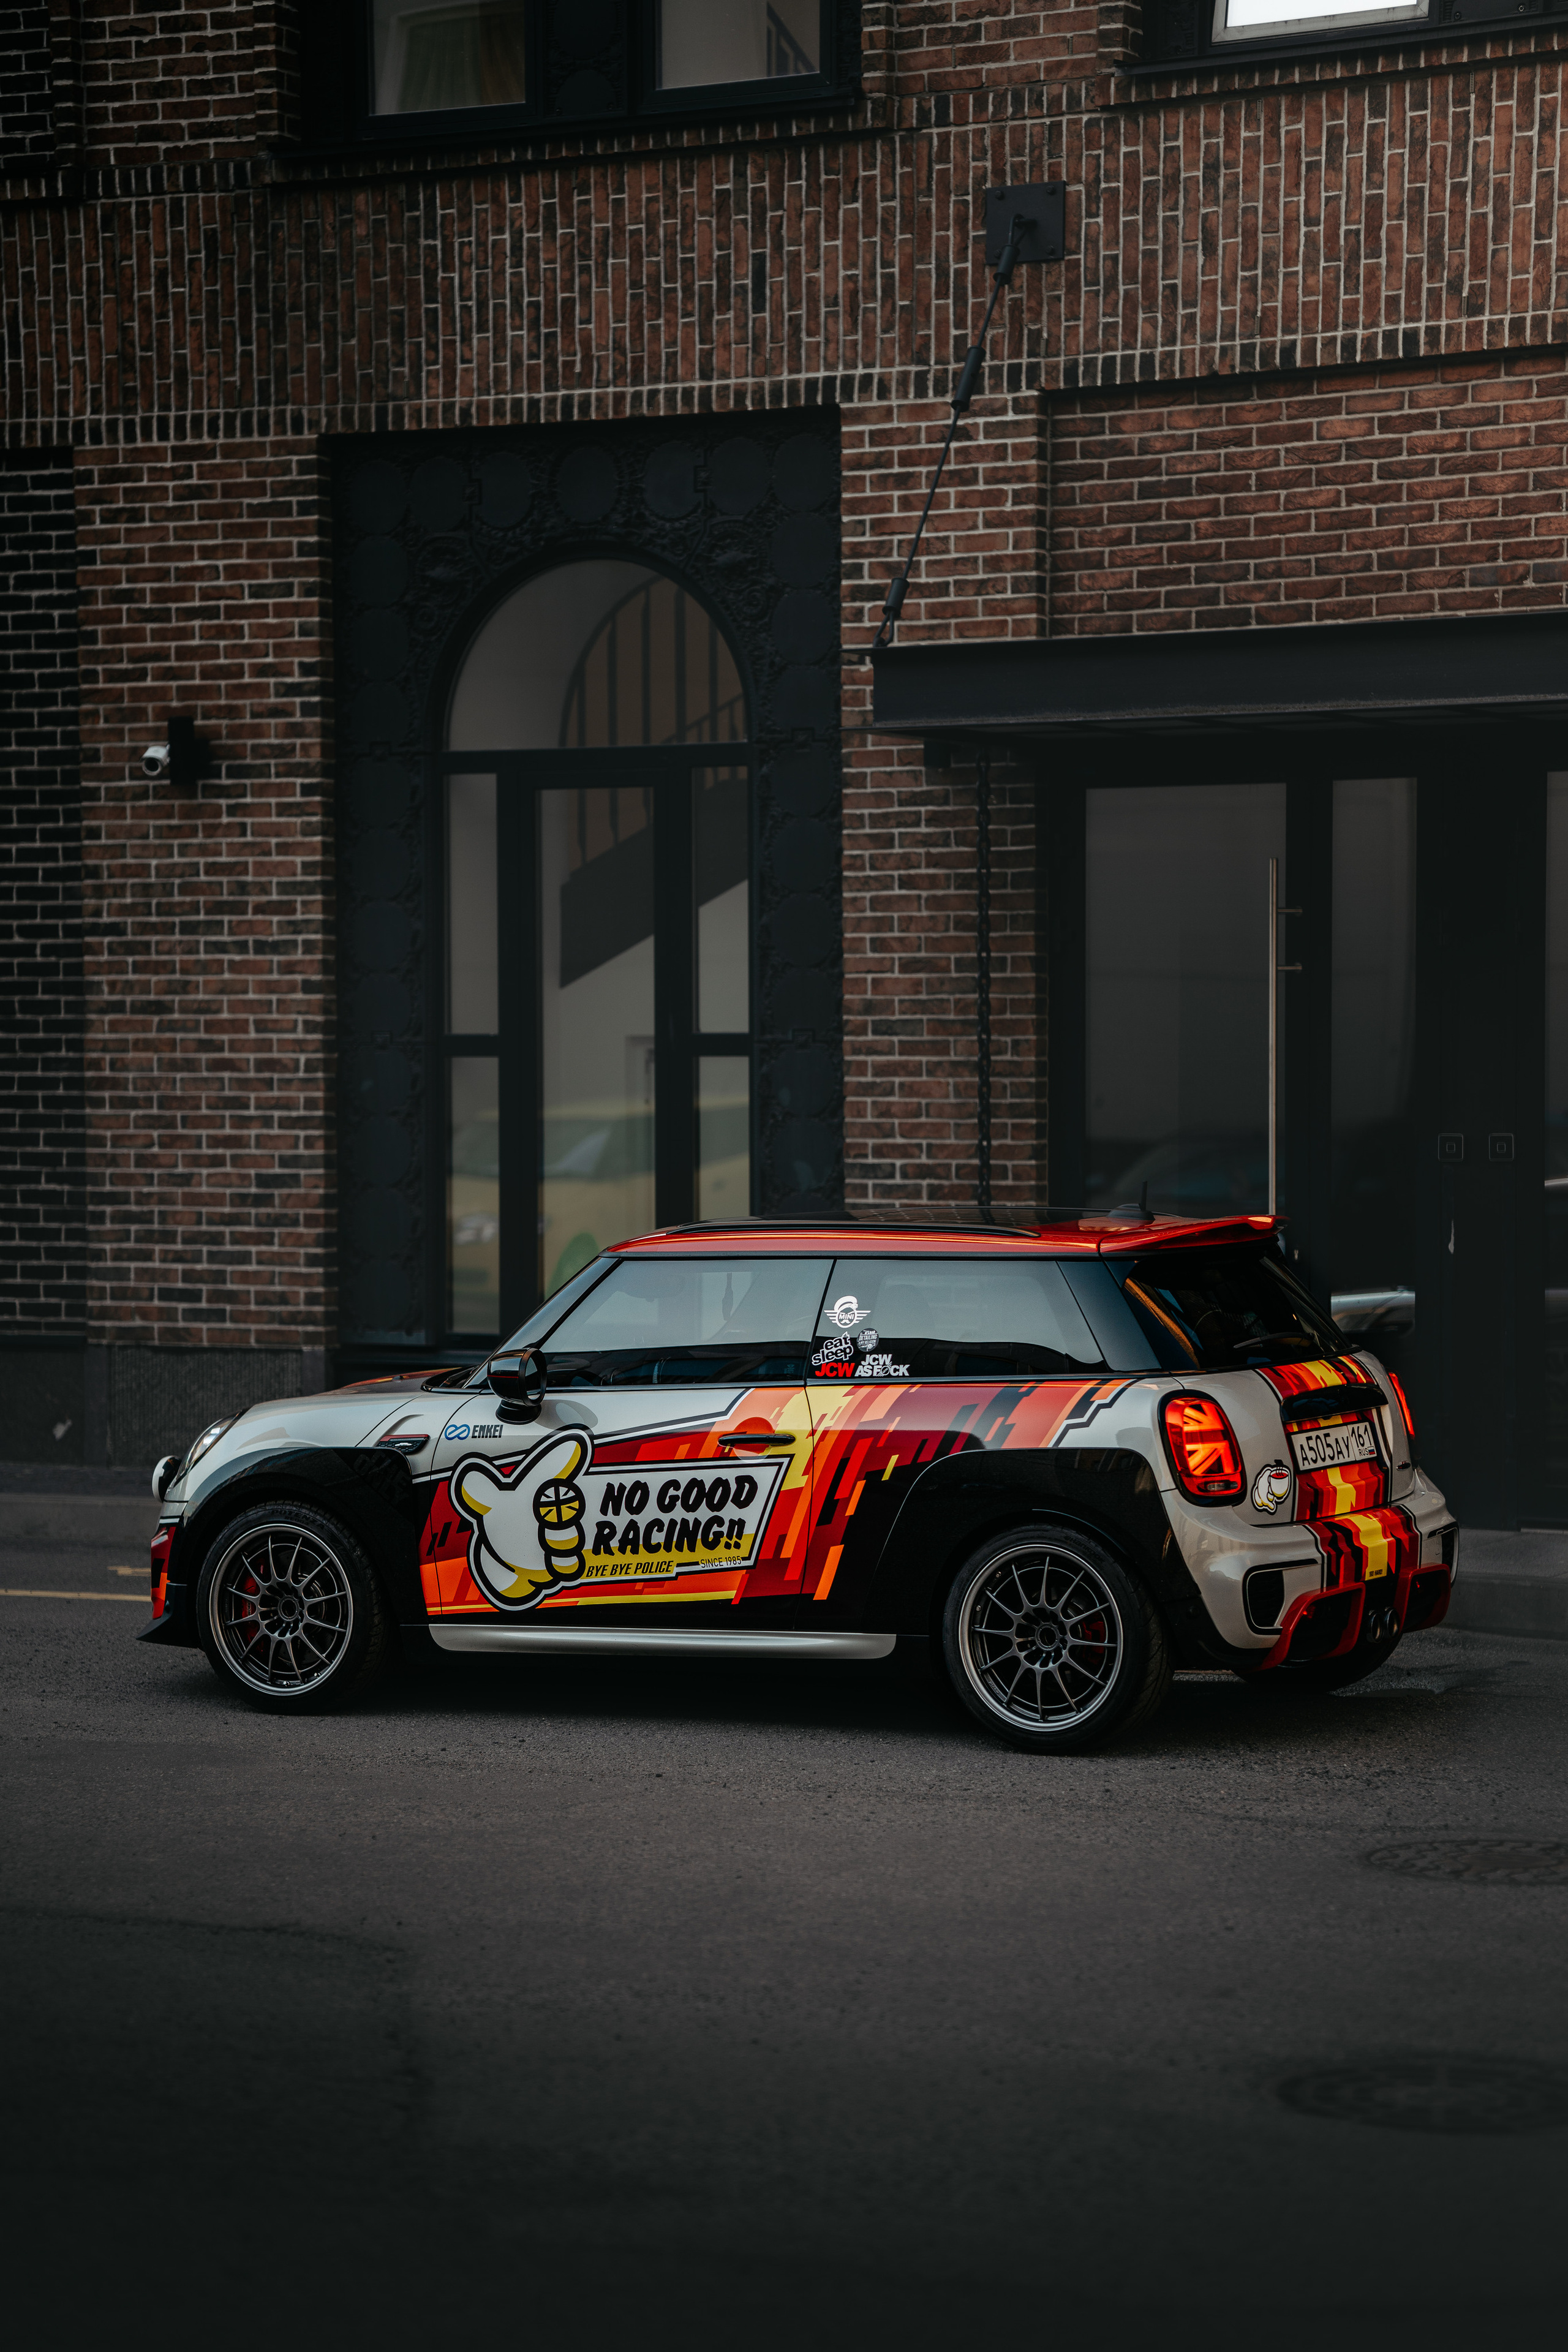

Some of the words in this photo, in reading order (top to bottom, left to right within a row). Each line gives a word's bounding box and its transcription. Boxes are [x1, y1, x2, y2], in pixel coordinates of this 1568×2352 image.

[824, 1332, 851, 1350] eat
[812, 1344, 854, 1366] sleep
[861, 1354, 892, 1365] JCW
[815, 1362, 856, 1378] JCW
[854, 1365, 873, 1377] AS
[471, 1424, 503, 1439] ENKEI
[1351, 1424, 1372, 1448] 161
[1358, 1447, 1369, 1457] RUS
[600, 1480, 650, 1517] NO
[656, 1475, 758, 1513] GOOD
[271, 1510, 325, 1530] POTENZA
[592, 1515, 746, 1556] RACING!!
[586, 1564, 609, 1577] BYE
[609, 1563, 633, 1576] BYE
[633, 1560, 674, 1574] POLICE
[700, 1558, 723, 1568] SINCE
[725, 1555, 742, 1566] 1985
